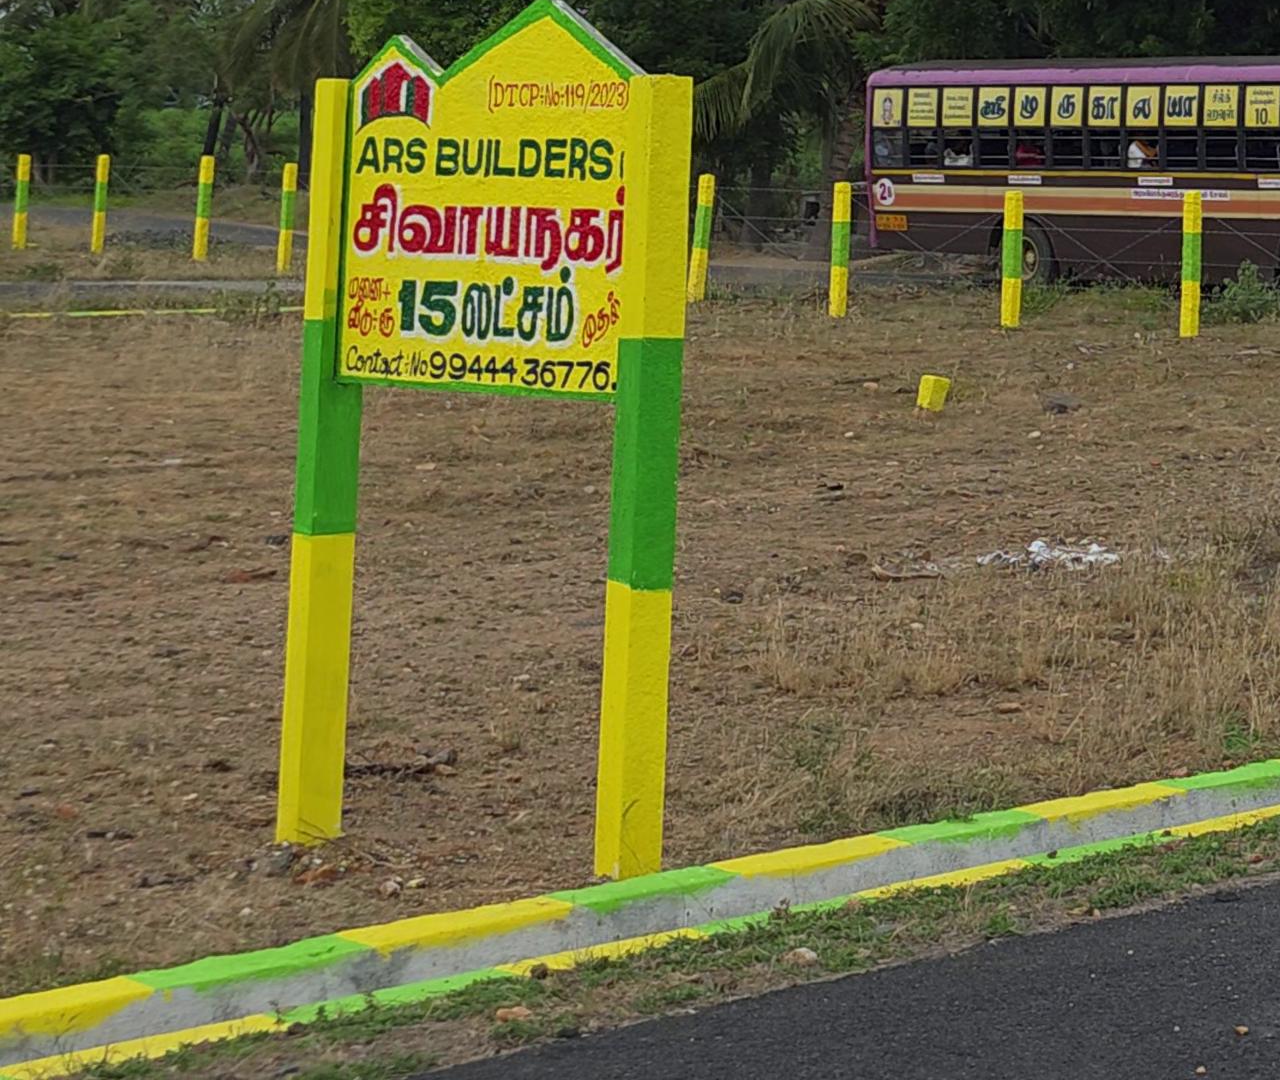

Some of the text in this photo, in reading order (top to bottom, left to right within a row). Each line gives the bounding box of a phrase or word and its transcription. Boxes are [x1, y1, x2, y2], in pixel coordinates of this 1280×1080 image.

[355, 135, 427, 174] ARS
[435, 137, 615, 181] BUILDERS
[398, 278, 459, 337] 15
